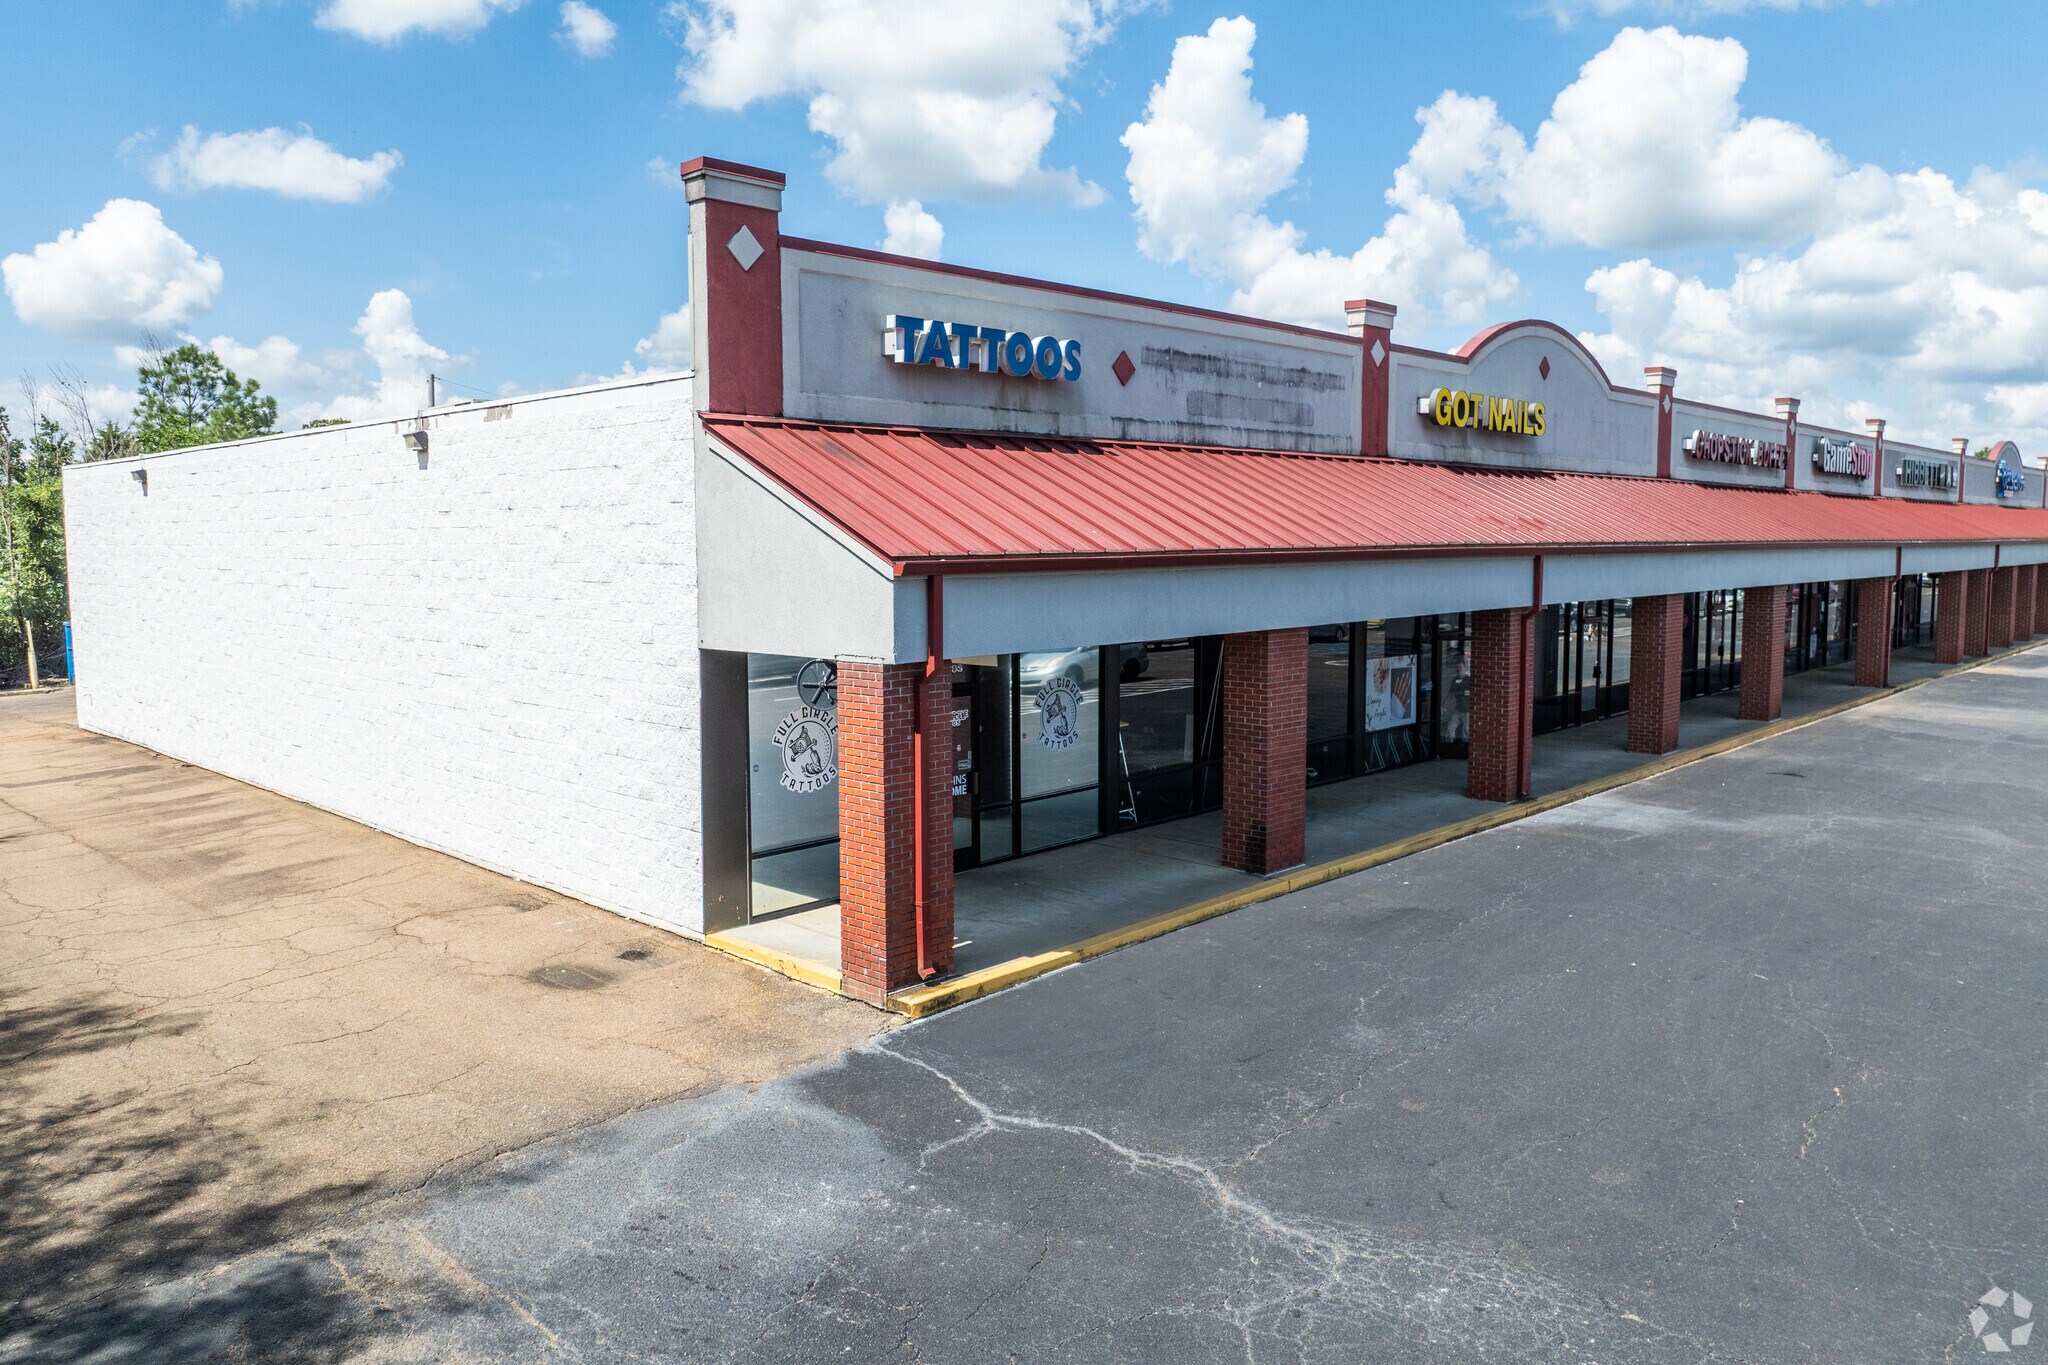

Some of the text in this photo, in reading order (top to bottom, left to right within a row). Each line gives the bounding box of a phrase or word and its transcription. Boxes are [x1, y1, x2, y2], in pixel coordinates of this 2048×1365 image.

[893, 314, 1082, 382] TATTOOS
[1434, 387, 1547, 437] GOT NAILS
[1695, 430, 1791, 470] CHOPSTICK BUFFET
[1823, 438, 1873, 480] GameStop
[1035, 678, 1084, 708] FULL CIRCLE
[773, 706, 839, 746] FULL CIRCLE
[1039, 731, 1079, 749] TATTOOS
[782, 766, 837, 792] TATTOOS
